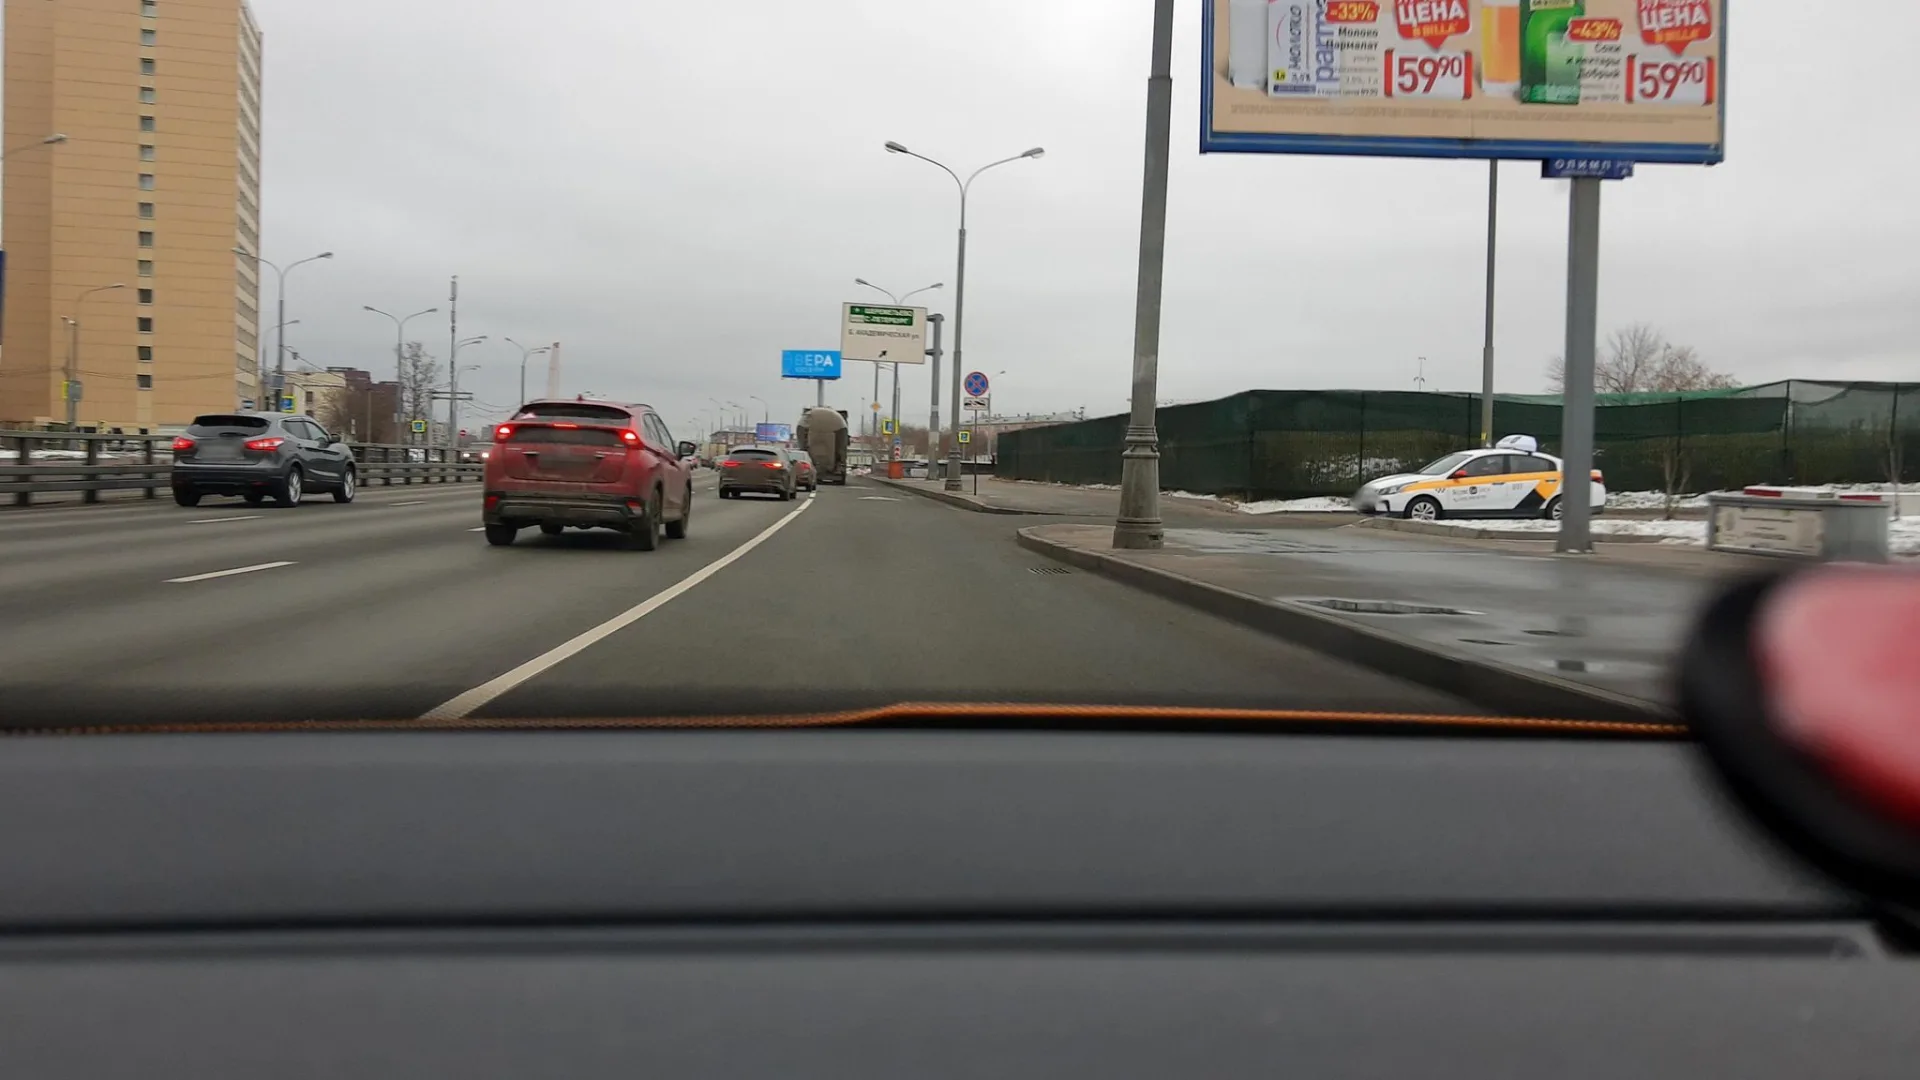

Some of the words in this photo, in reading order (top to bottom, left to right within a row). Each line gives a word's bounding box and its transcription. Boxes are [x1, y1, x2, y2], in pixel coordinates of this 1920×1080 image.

[1329, 2, 1375, 20] -33%
[1398, 0, 1466, 27] ЦЕНА
[1641, 4, 1708, 33] ЦЕНА
[1572, 20, 1618, 39] -43%
